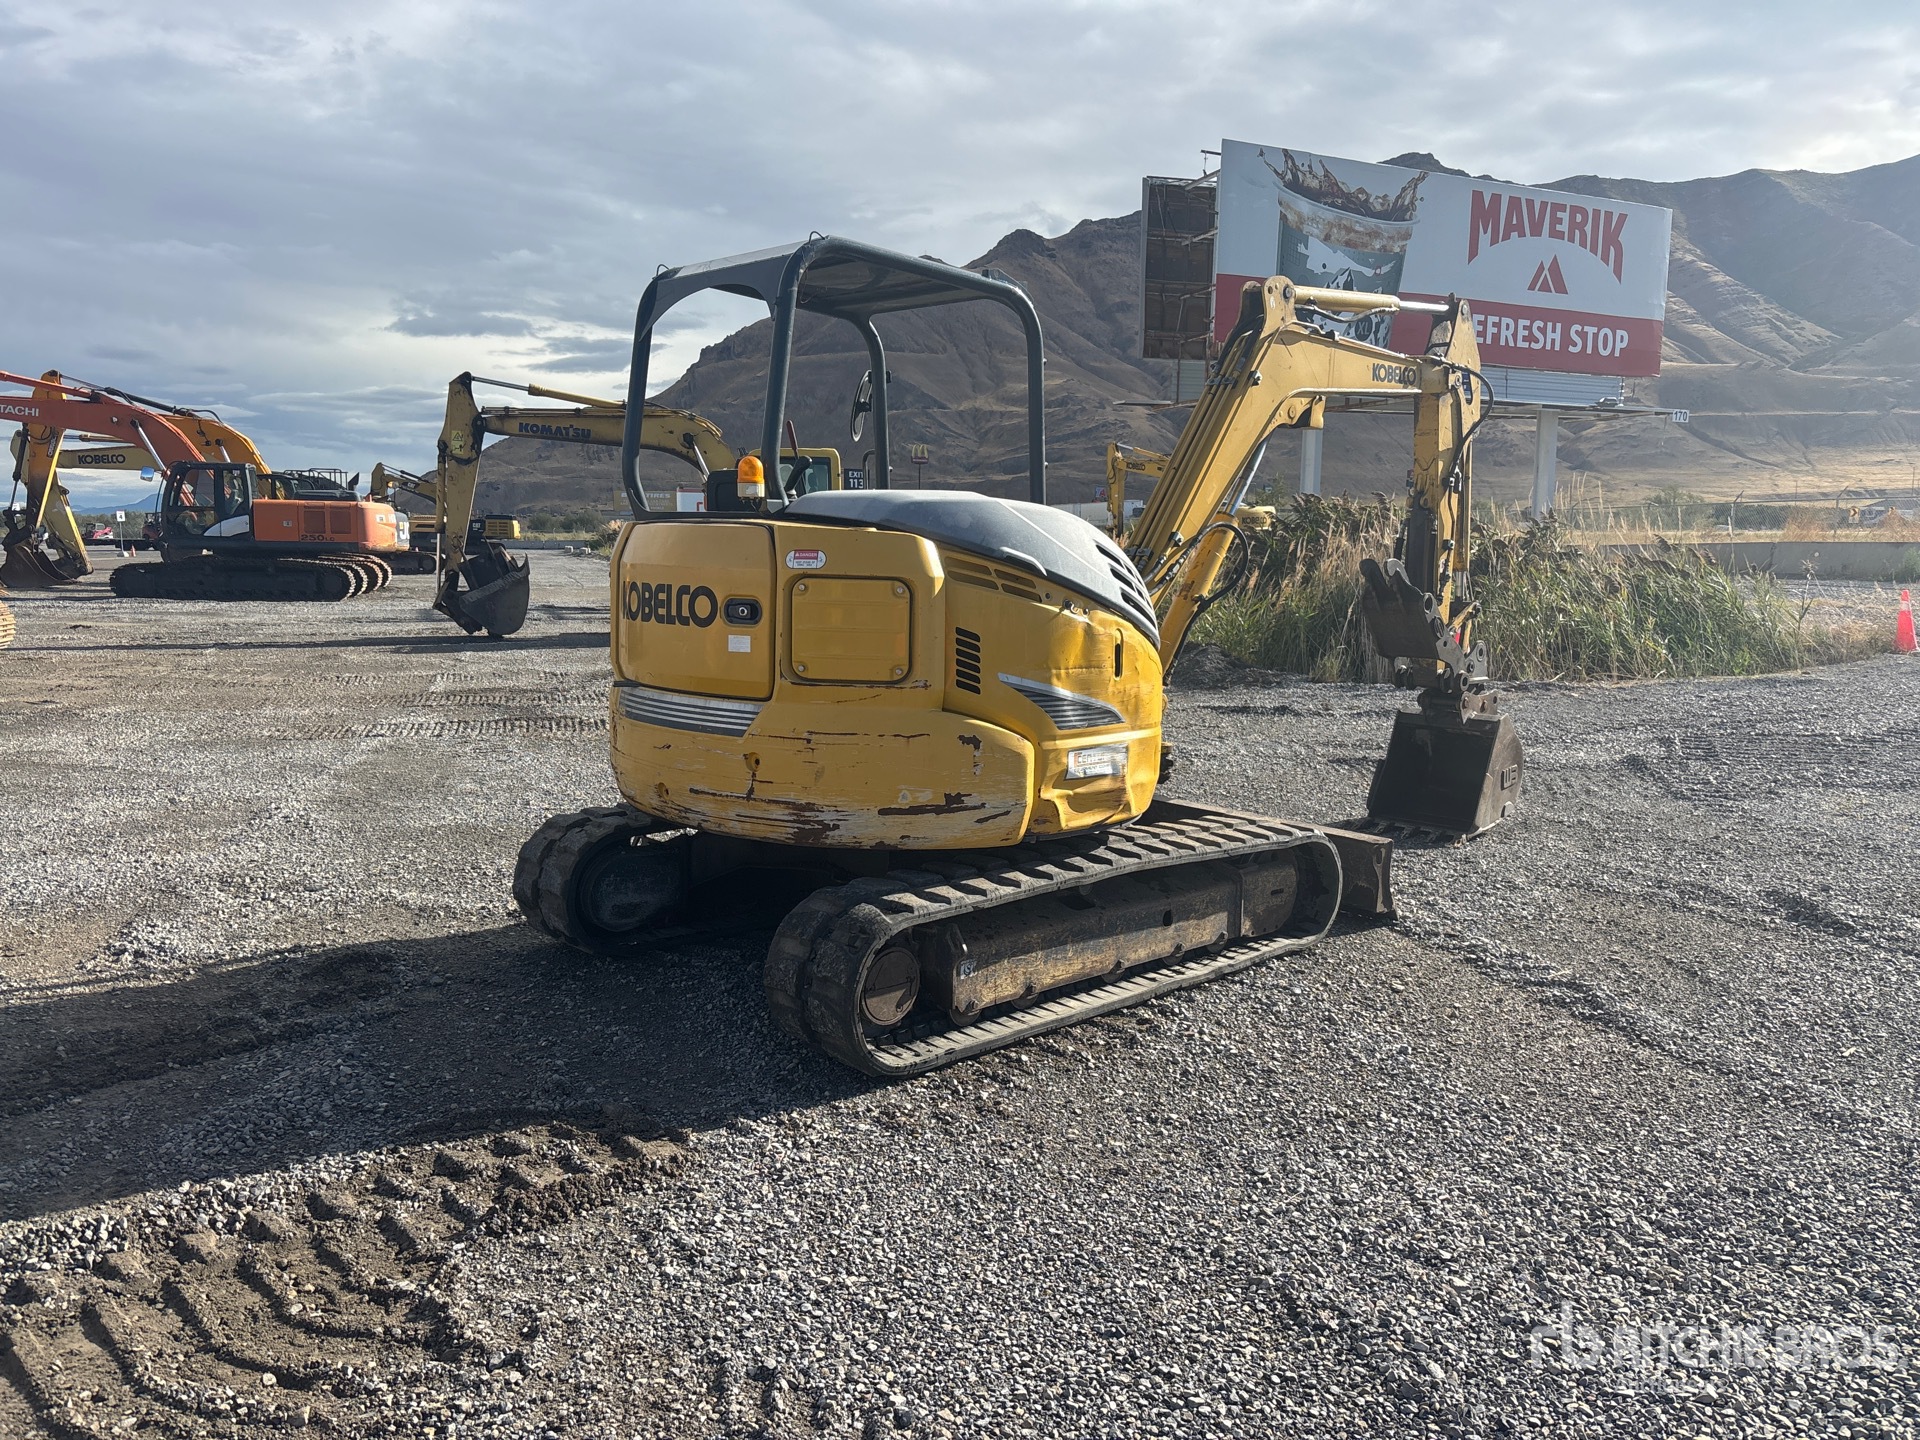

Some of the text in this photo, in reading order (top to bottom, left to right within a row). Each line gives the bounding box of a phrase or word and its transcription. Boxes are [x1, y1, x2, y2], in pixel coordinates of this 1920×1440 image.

[1467, 189, 1629, 285] MAVERIK
[1357, 321, 1371, 335] XL
[1472, 313, 1629, 357] EFRESH STOP
[1372, 362, 1417, 386] KOBELCO
[1673, 410, 1688, 422] 170
[518, 422, 592, 439] KOMATSU
[77, 453, 126, 465] KOBELCO
[848, 478, 864, 489] 113
[622, 580, 719, 628] KOBELCO
